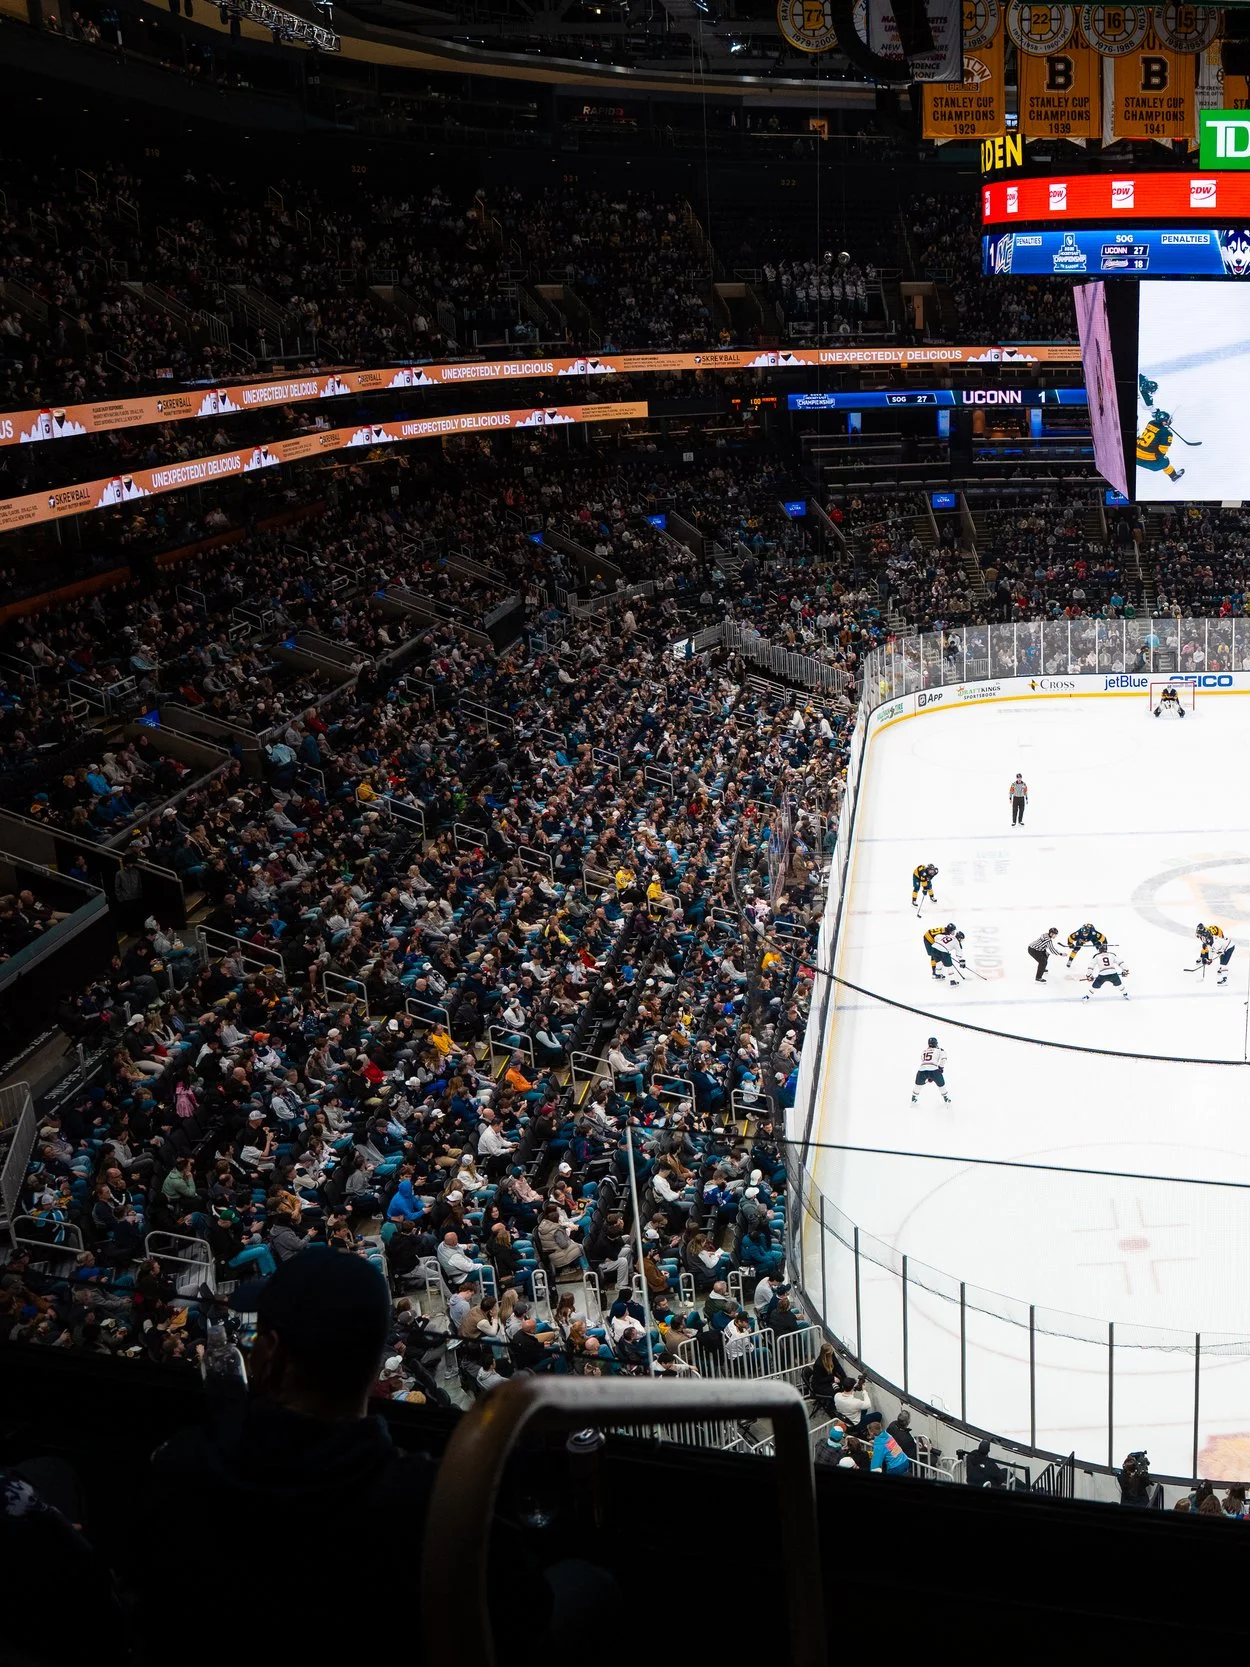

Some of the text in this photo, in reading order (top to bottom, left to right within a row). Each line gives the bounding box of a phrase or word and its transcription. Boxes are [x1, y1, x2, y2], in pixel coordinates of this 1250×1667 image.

[804, 9, 824, 22] 77
[1032, 13, 1048, 25] 22
[1106, 13, 1121, 28] 16
[1045, 55, 1075, 92] B
[1140, 55, 1169, 93] B
[933, 97, 994, 108] STANLEY CUP
[1029, 97, 1090, 108] STANLEY CUP
[1124, 97, 1184, 109] STANLEY CUP
[933, 111, 995, 122] CHAMPIONS
[1029, 110, 1091, 121] CHAMPIONS
[1124, 110, 1185, 121] CHAMPIONS
[953, 124, 976, 135] 1929
[1049, 123, 1071, 134] 1939
[1144, 123, 1165, 134] 1941
[1017, 237, 1041, 246] PENALTIES
[1116, 235, 1134, 243] SOG
[1162, 235, 1208, 244] PENALTIES
[1105, 246, 1144, 255] UCONN 27
[1134, 260, 1144, 269] 18
[702, 354, 740, 363] SKREWBALL
[819, 349, 962, 362] UNEXPECTEDLY DELICIOUS
[441, 362, 554, 379] UNEXPECTEDLY DELICIOUS
[242, 381, 318, 405] UNEXPECTEDLY DELICIOUS
[962, 390, 1046, 405] UCONN 1
[161, 397, 192, 411] SKREWBALL
[401, 414, 511, 436] UNEXPECTEDLY DELICIOUS
[151, 456, 241, 488] UNEXPECTEDLY DELICIOUS
[55, 487, 91, 505] SKREWBALL
[1104, 675, 1148, 690] jetBlue
[964, 692, 996, 700] SPORTSBOOK
[972, 926, 1004, 981] RAPID7
[1102, 957, 1110, 967] 9
[923, 1051, 934, 1061] 15
